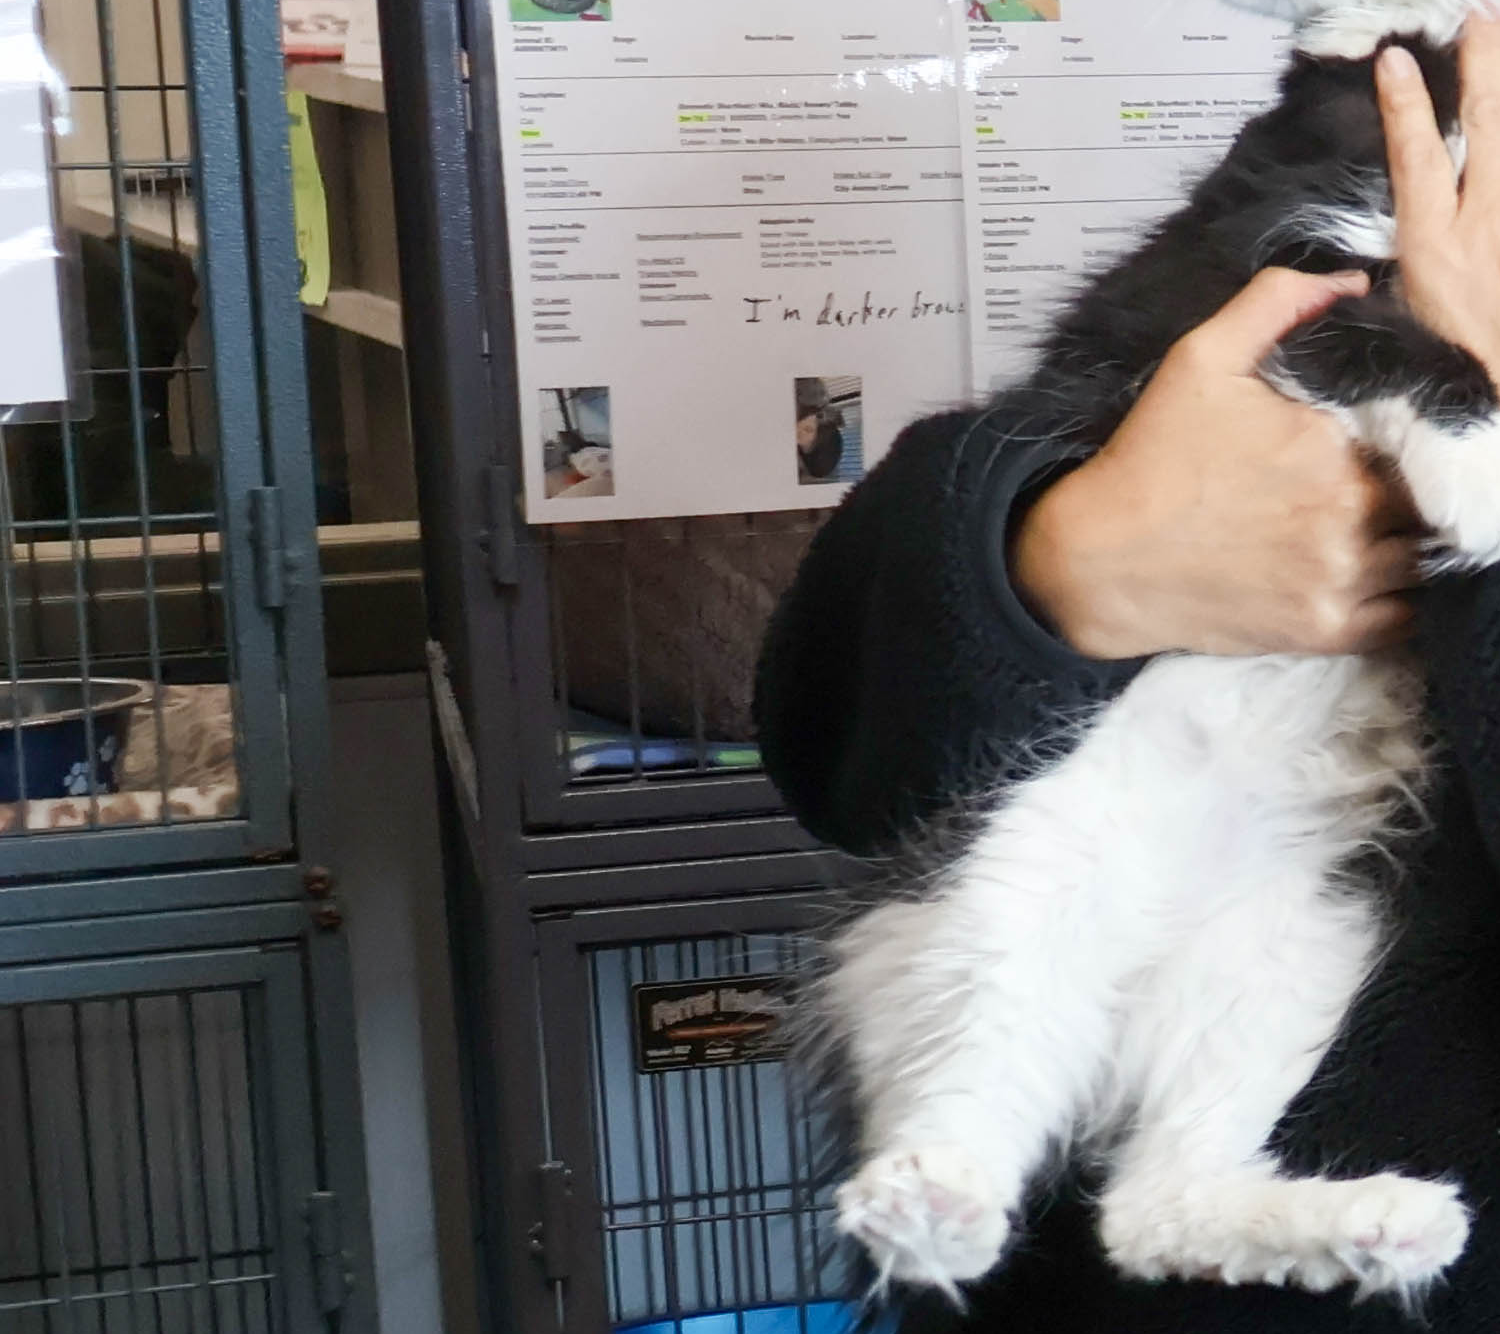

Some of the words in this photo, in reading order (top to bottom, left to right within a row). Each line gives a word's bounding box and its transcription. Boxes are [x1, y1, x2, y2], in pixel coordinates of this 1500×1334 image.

[743, 291, 802, 324] I'm
[816, 292, 898, 327] darker
[910, 290, 966, 319] brow
